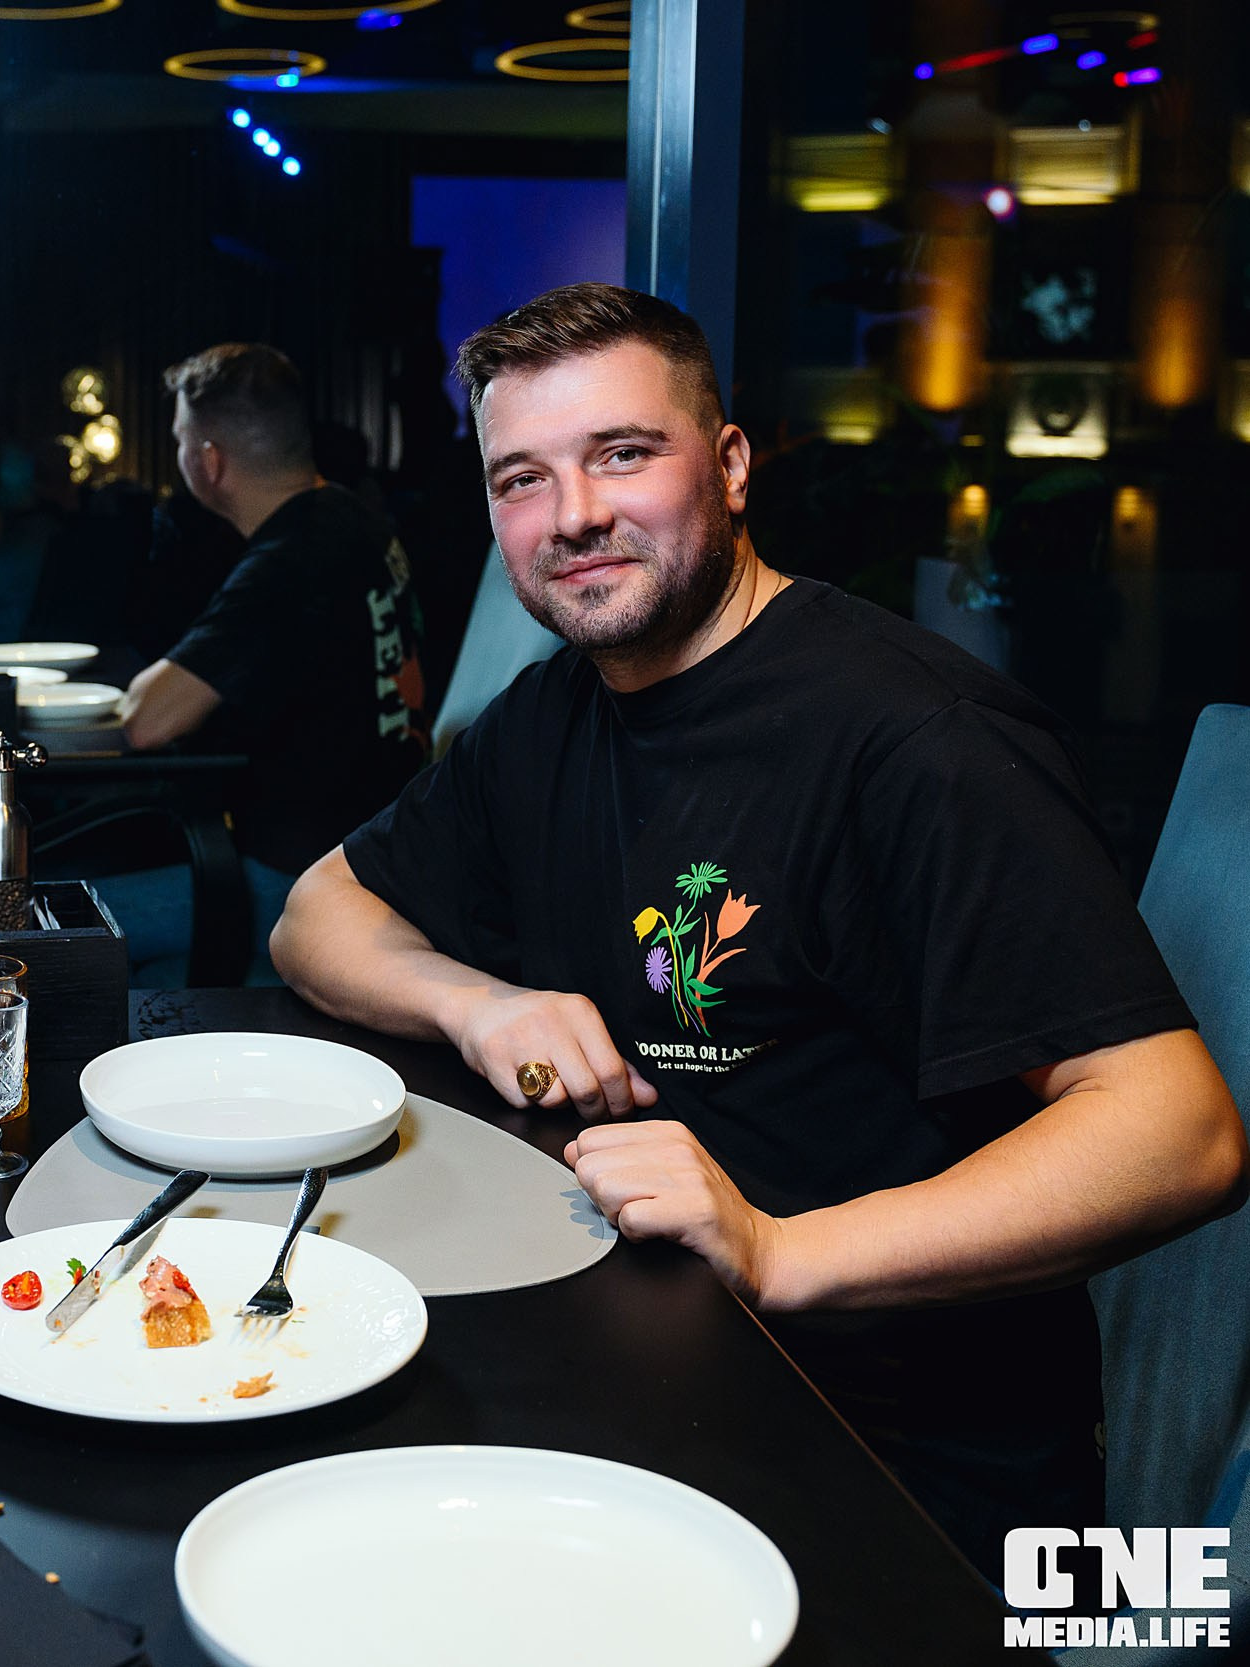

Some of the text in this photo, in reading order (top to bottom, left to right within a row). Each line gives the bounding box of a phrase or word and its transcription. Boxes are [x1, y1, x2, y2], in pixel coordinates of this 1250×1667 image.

[635, 1041, 697, 1059] OONER
[699, 1045, 718, 1061] OR
[657, 1061, 673, 1070] Let
[674, 1062, 684, 1070] us
[685, 1062, 703, 1073] hope
